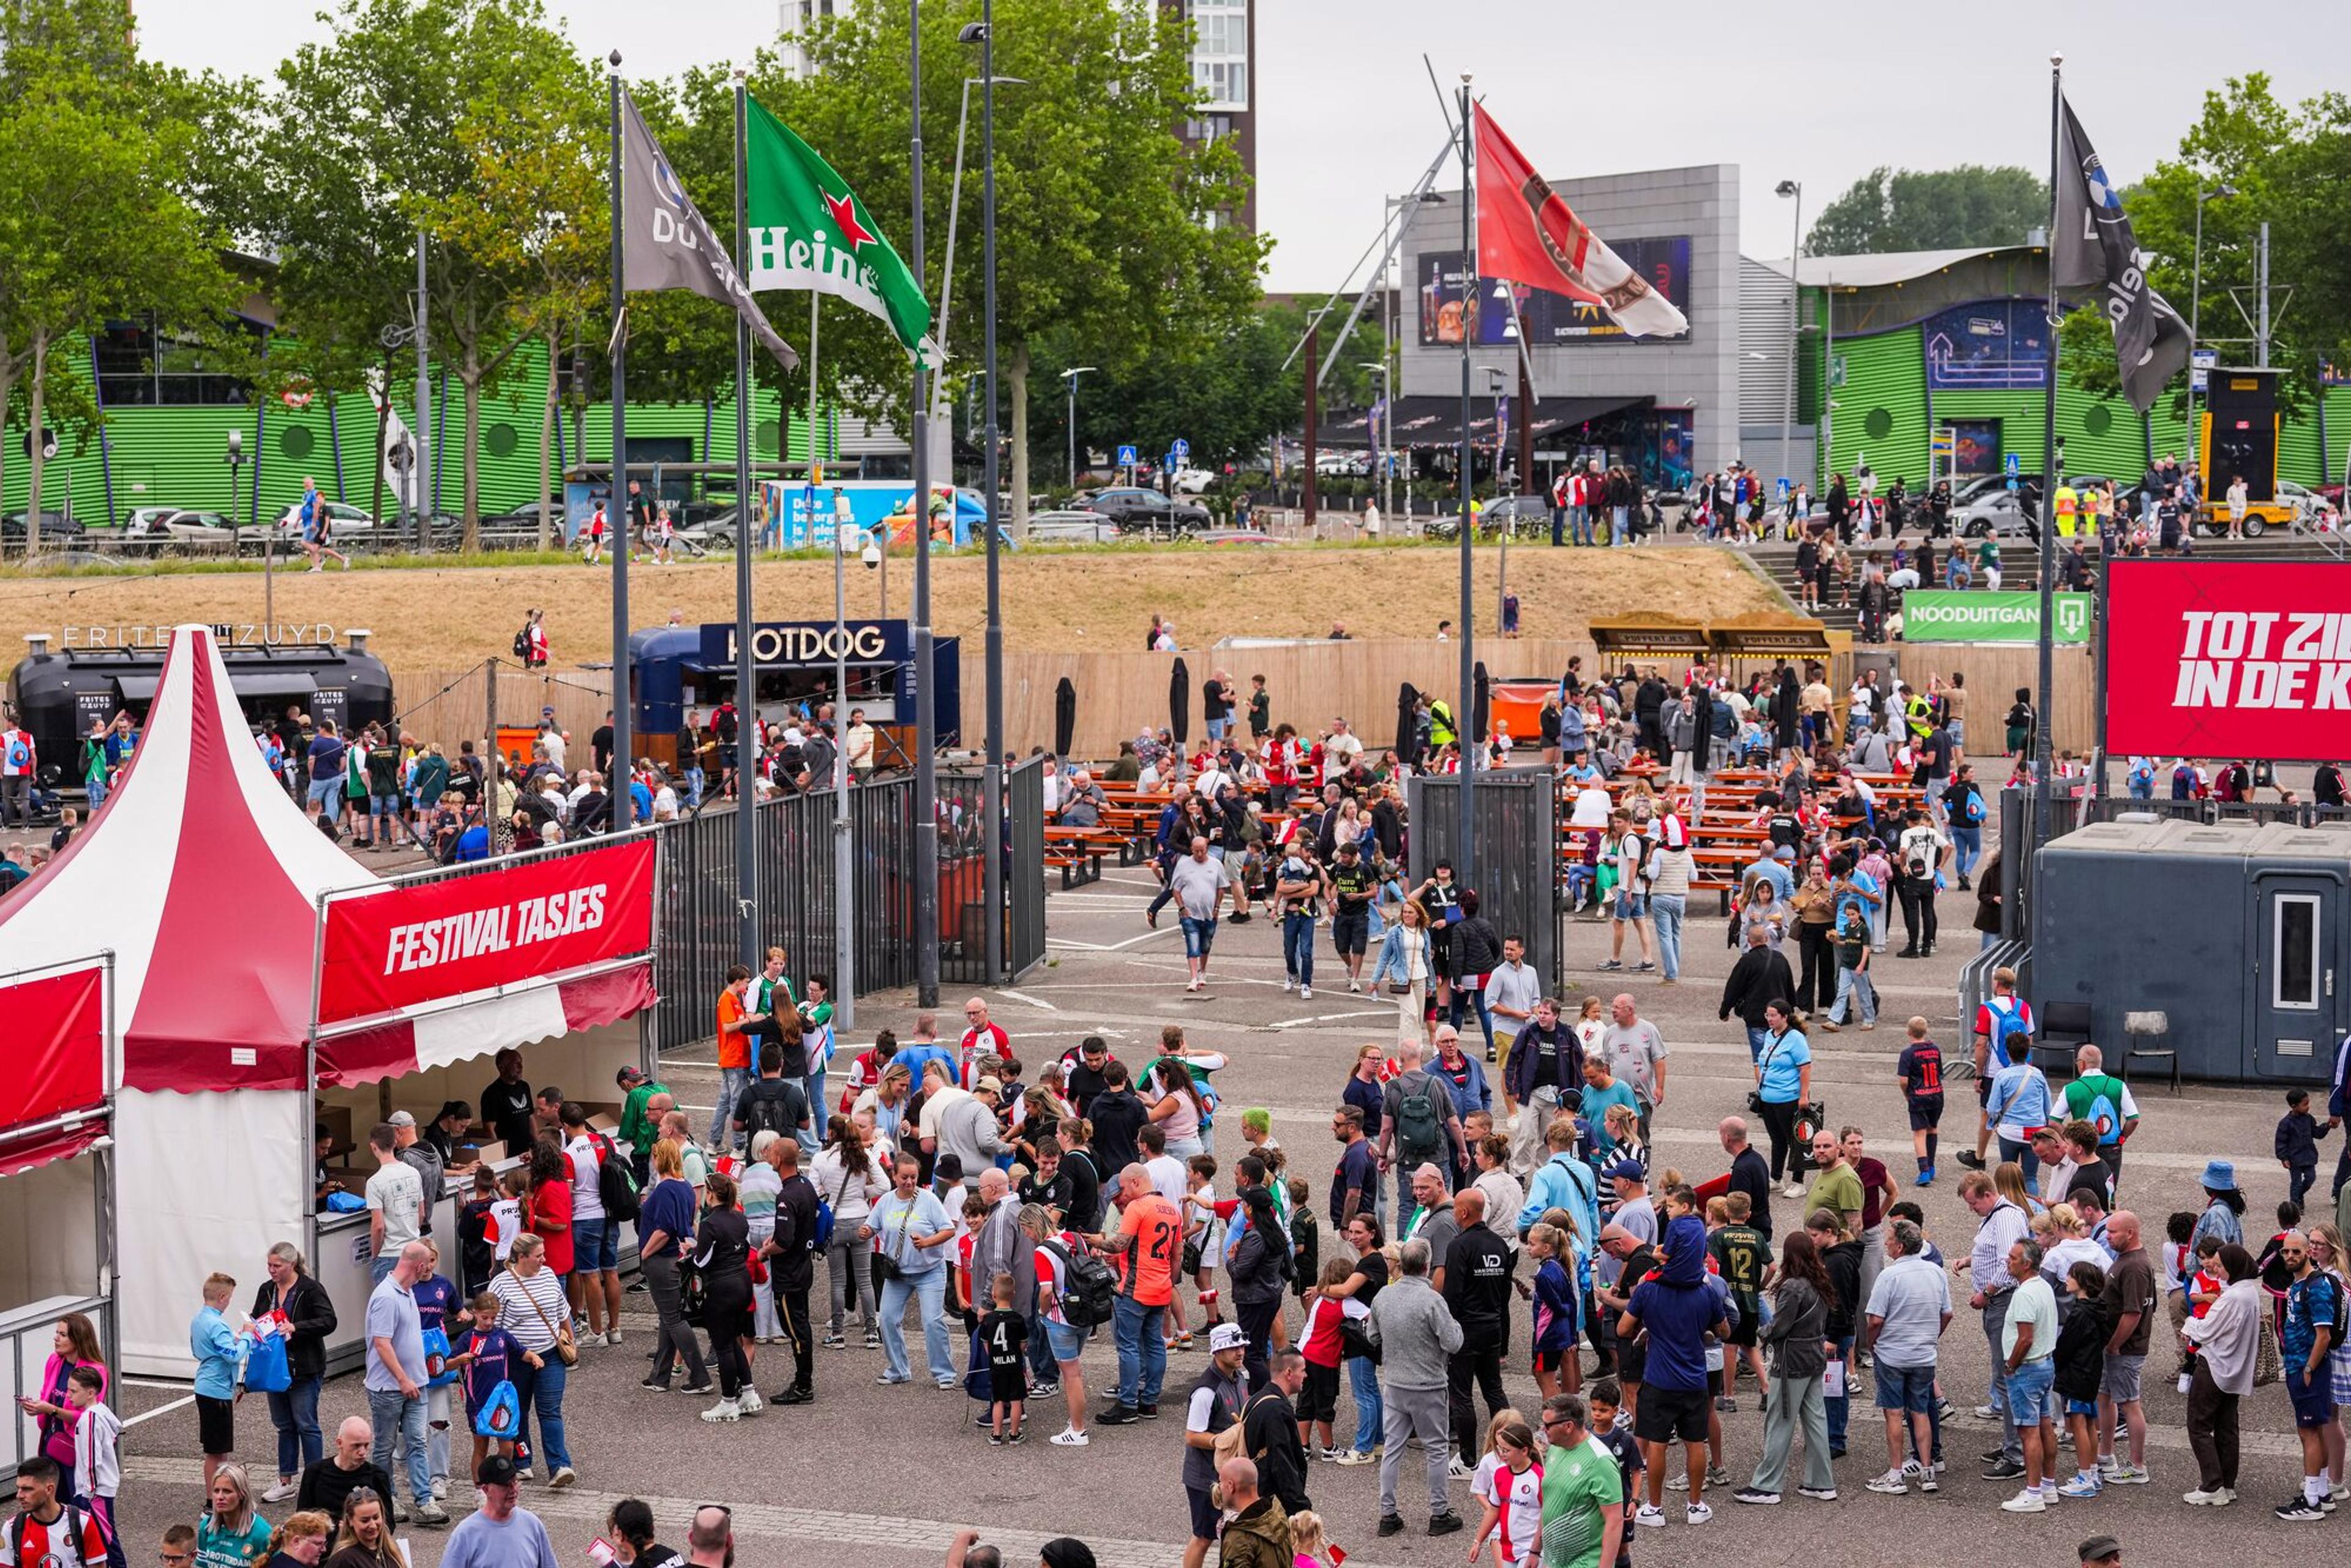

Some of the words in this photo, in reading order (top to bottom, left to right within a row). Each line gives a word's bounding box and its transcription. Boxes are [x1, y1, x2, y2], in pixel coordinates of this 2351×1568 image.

[1911, 606, 2040, 623] NOODUITGAN
[63, 626, 172, 648] FRITE
[239, 623, 335, 646] ZUYD
[2181, 611, 2281, 659] TOT
[2172, 660, 2234, 708] IN
[2235, 661, 2311, 709] DE
[383, 907, 512, 976] FESTIVAL
[515, 883, 607, 947] TASJES
[1150, 1221, 1178, 1259] 21
[1729, 1248, 1751, 1278] 12
[992, 1321, 1008, 1352] 4
[992, 1354, 1017, 1365] MILAN
